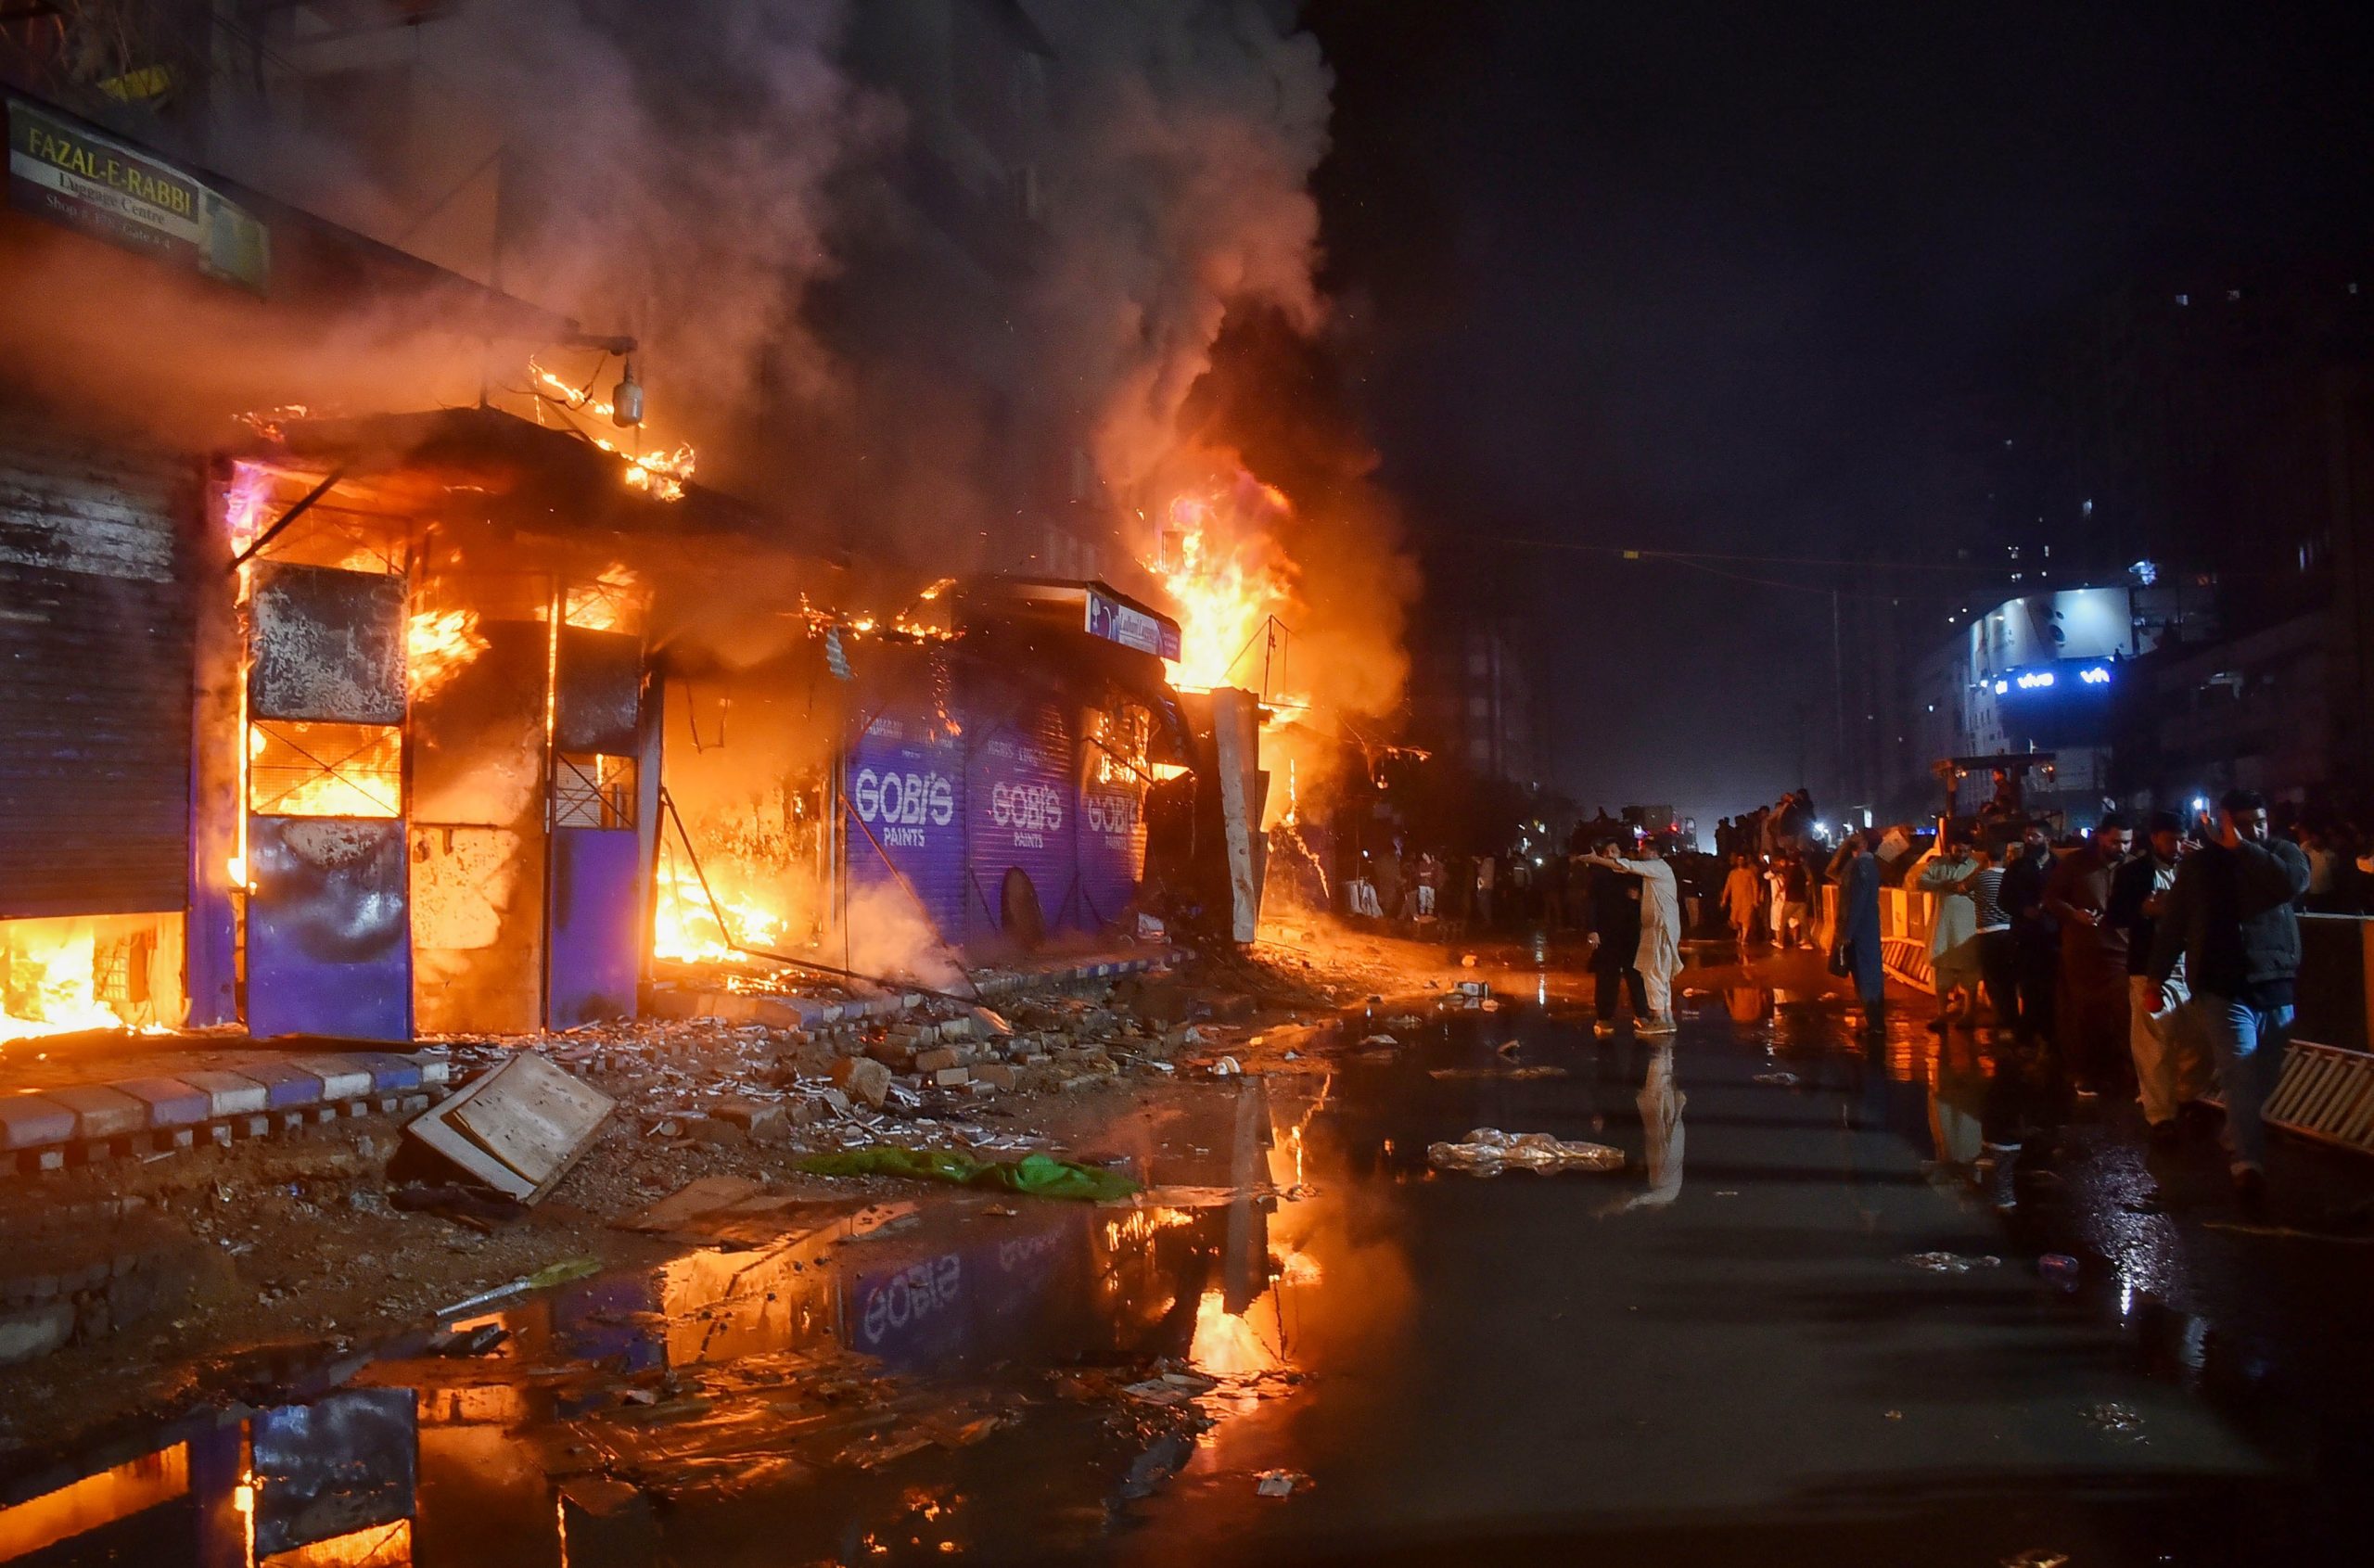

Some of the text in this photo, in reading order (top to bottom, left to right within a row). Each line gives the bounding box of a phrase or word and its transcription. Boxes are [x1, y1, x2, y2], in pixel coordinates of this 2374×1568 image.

[29, 126, 192, 216] FAZAL-E-RABBI
[121, 195, 166, 224] Centre
[855, 769, 954, 826] GOBI'S
[992, 781, 1063, 833] GOBI'S
[883, 828, 925, 848] PAINTS
[1014, 831, 1044, 850] PAINTS
